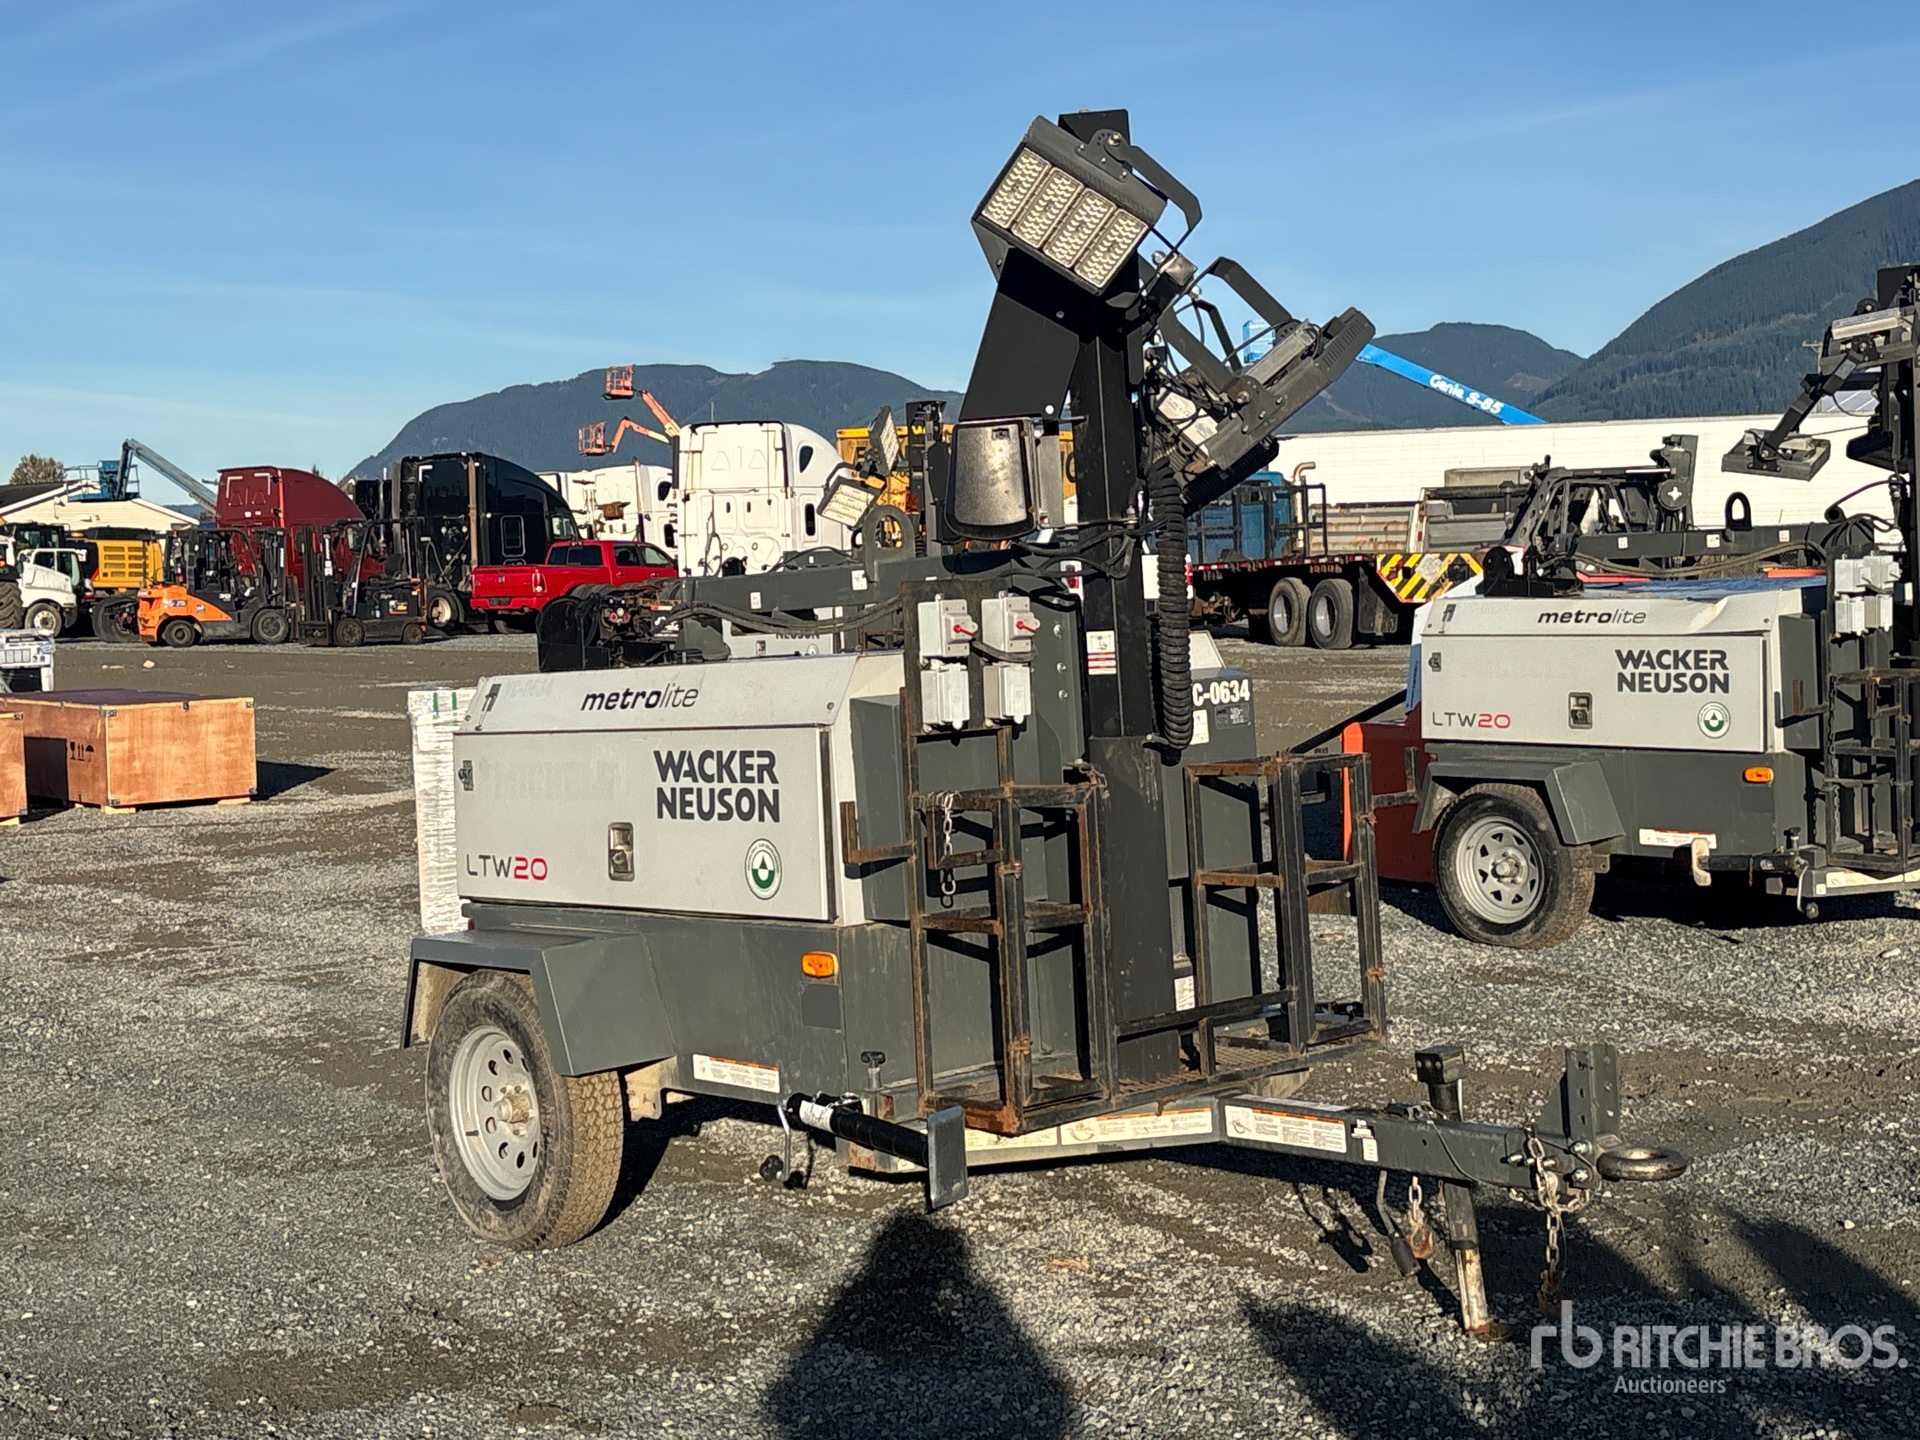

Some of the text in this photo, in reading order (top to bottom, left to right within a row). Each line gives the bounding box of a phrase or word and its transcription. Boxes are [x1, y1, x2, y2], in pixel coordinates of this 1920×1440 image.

[1429, 374, 1504, 415] Genie S-85
[1537, 608, 1647, 624] metrolite
[1614, 649, 1729, 670] WACKER
[580, 683, 699, 711] metrolite
[1190, 679, 1251, 707] C-0634
[1617, 672, 1730, 694] NEUSON
[1432, 711, 1511, 729] LTW20
[653, 749, 779, 784] WACKER
[656, 787, 780, 823] NEUSON
[466, 853, 548, 881] LTW20
